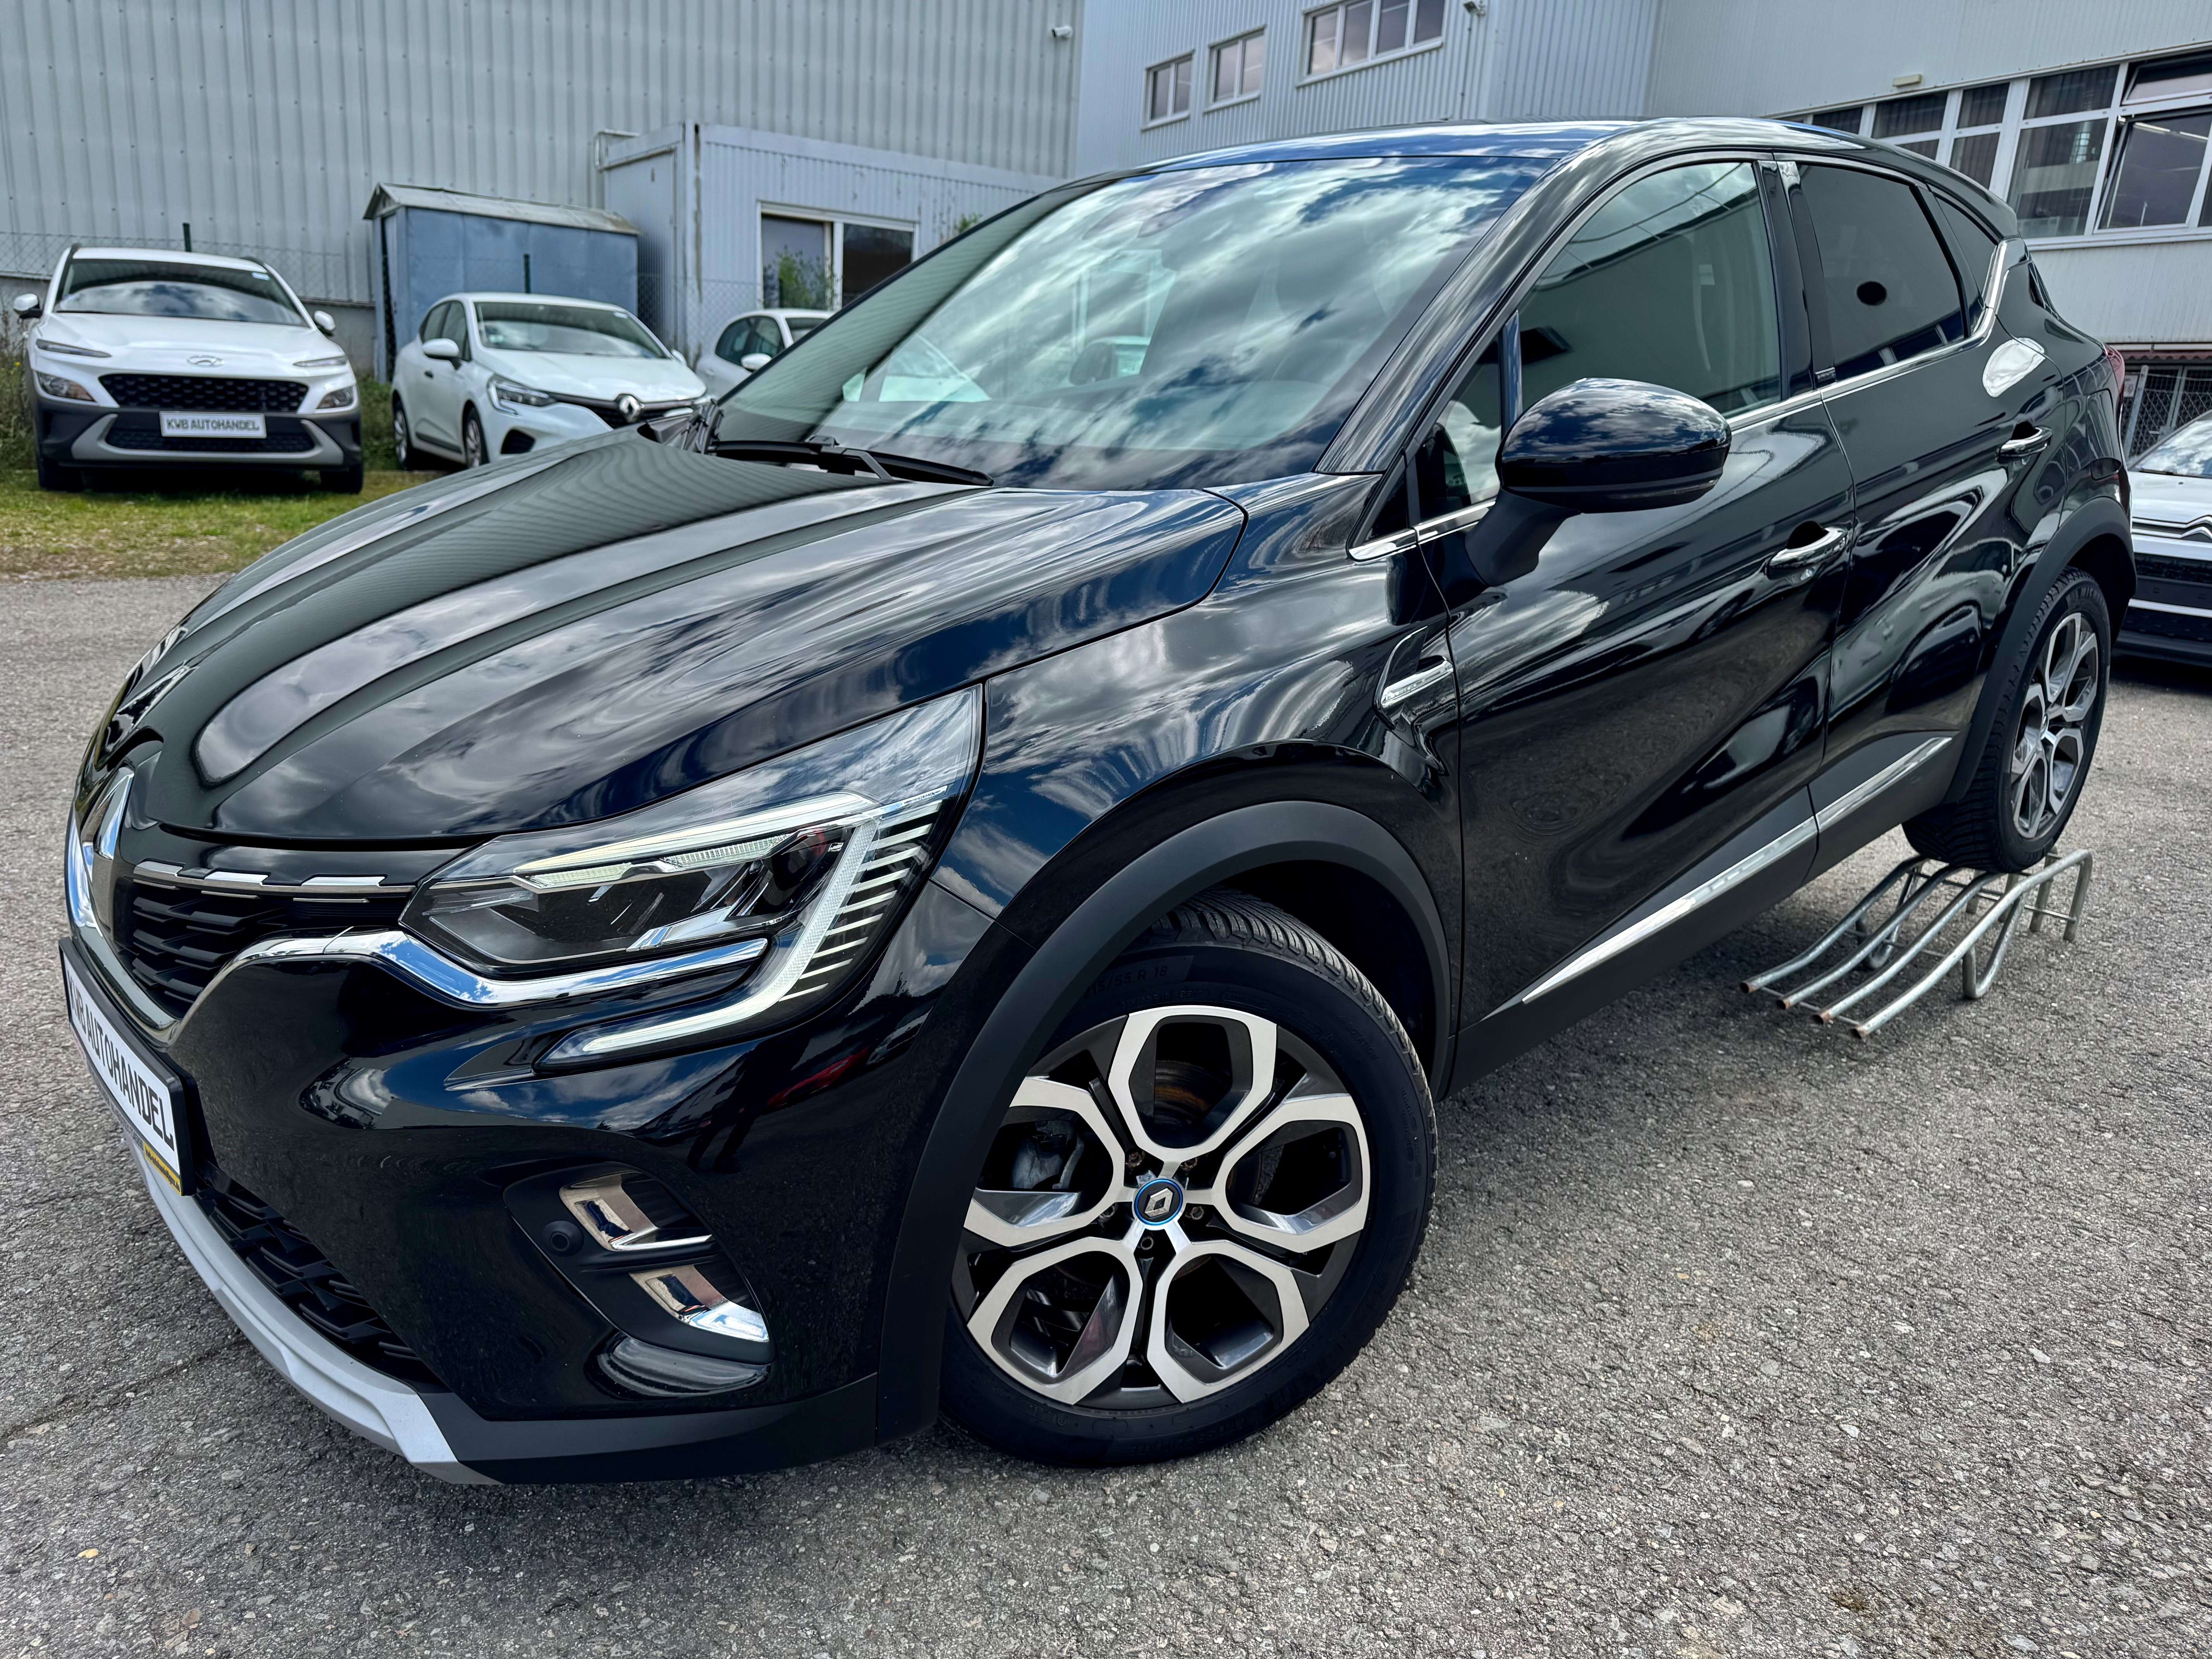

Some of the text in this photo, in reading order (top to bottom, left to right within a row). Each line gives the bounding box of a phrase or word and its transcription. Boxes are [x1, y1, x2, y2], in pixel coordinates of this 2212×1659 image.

[166, 418, 260, 431] KWB AUTOHANDEL
[1137, 969, 1147, 981] R
[1154, 966, 1168, 978] 18
[67, 970, 86, 1035] KWB
[85, 1003, 174, 1152] AUTOHANDEL
